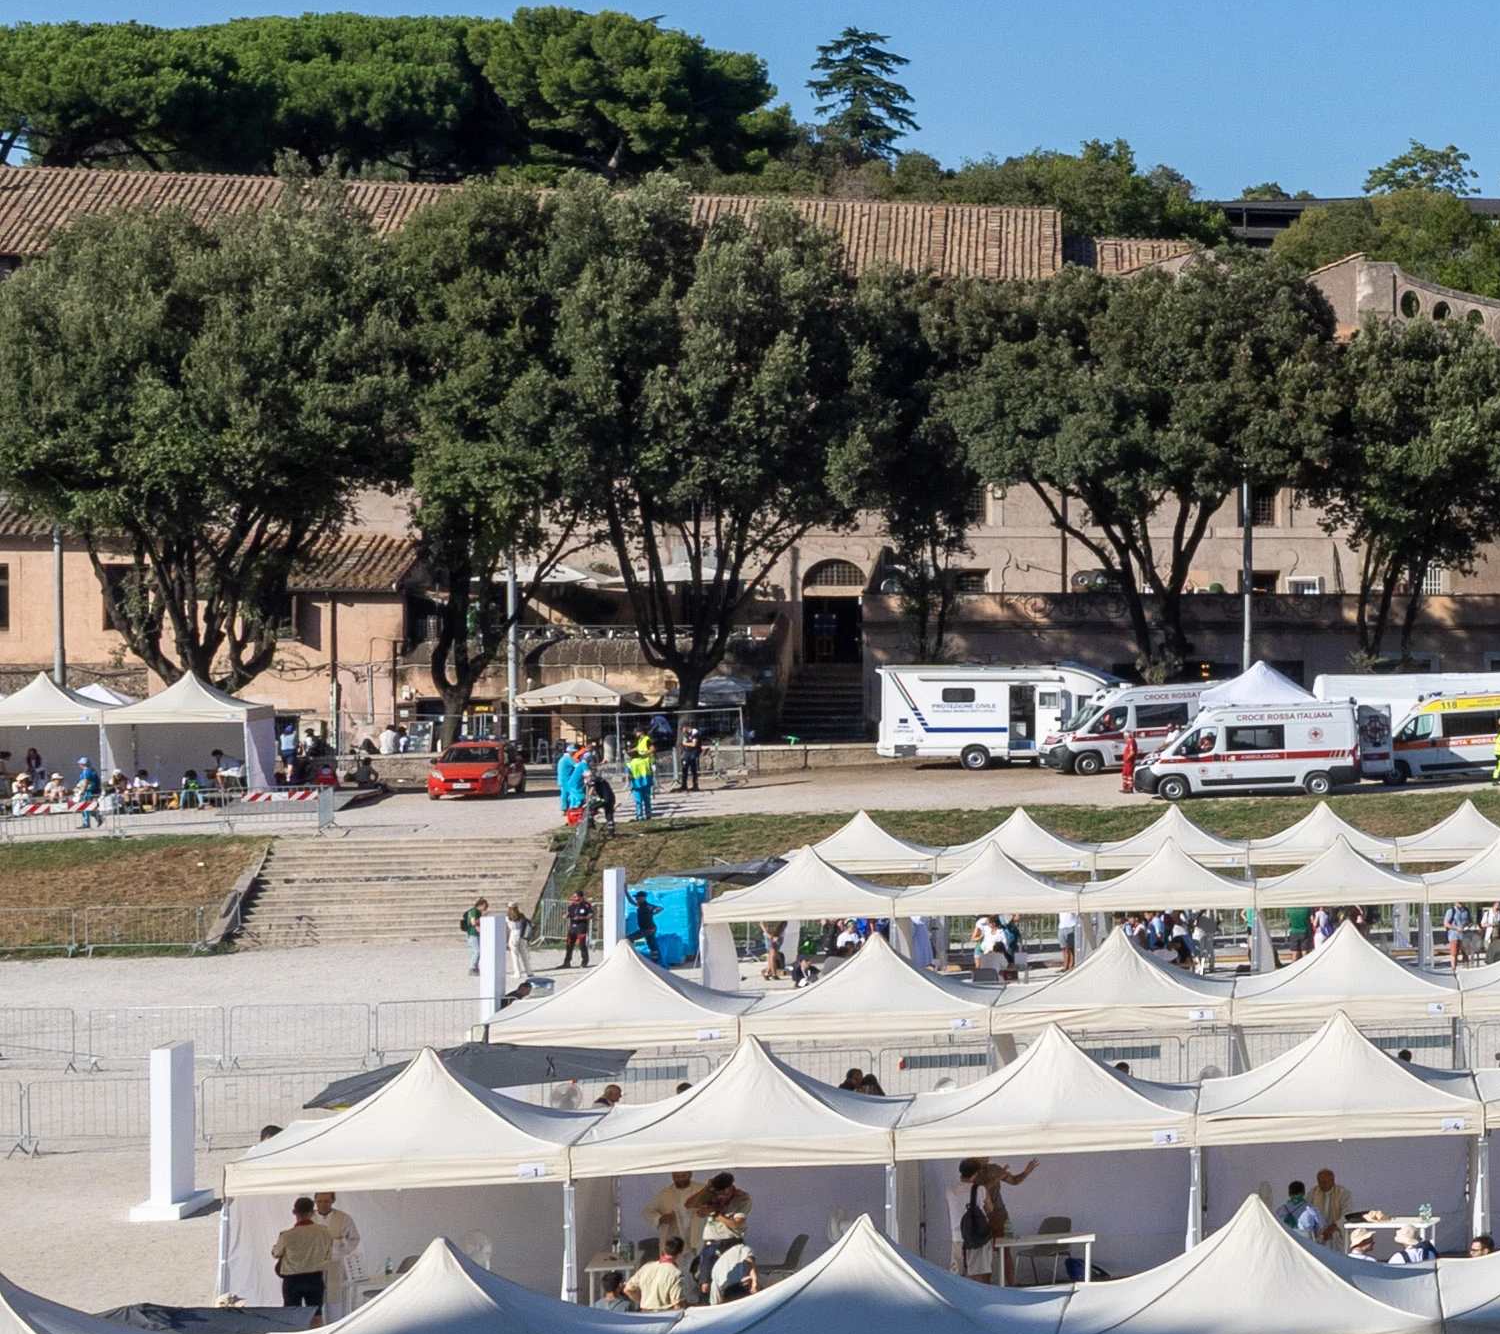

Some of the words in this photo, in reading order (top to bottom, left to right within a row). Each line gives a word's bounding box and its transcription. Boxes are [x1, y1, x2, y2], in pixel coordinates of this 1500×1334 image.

[1441, 701, 1458, 710] 118
[1236, 714, 1264, 722] CROCE
[1267, 712, 1295, 720] ROSSA
[1296, 711, 1334, 719] ITALIANA
[960, 1018, 968, 1027] 2
